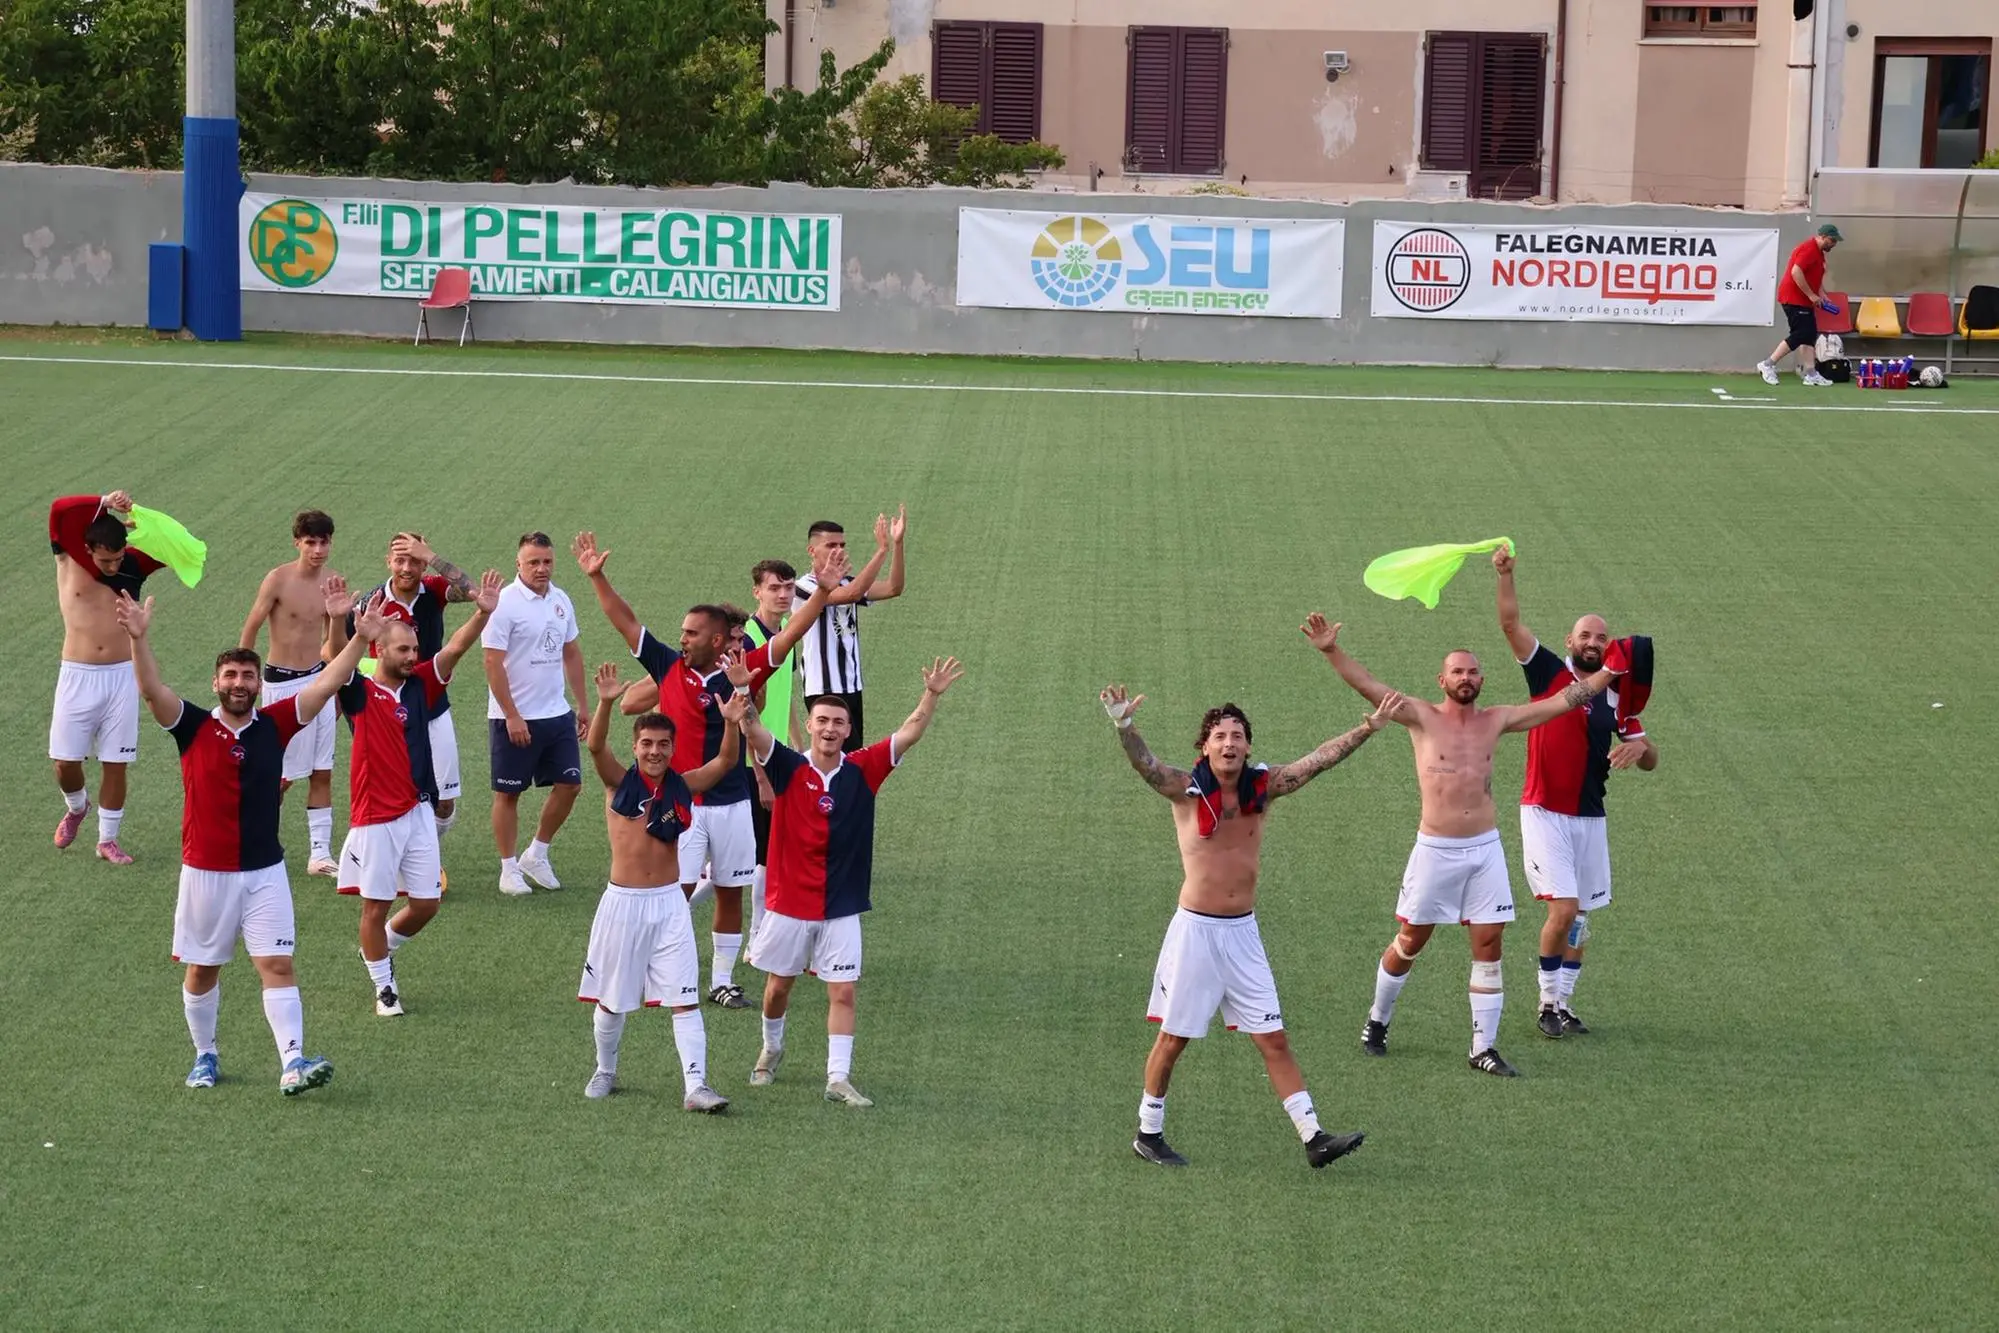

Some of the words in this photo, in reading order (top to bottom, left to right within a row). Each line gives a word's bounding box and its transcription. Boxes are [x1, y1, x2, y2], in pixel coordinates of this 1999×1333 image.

[381, 205, 441, 258] DI
[464, 206, 829, 271] PELLEGRINI
[1495, 233, 1717, 257] FALEGNAMERIA
[1126, 225, 1269, 289] SEU
[383, 263, 581, 293] SERAMENTI
[610, 269, 826, 303] CALANGIANUS
[1412, 260, 1449, 282] NL
[1725, 278, 1754, 291] s.r.l.
[1125, 289, 1188, 307] GREEN
[1192, 291, 1269, 311] ENERGY
